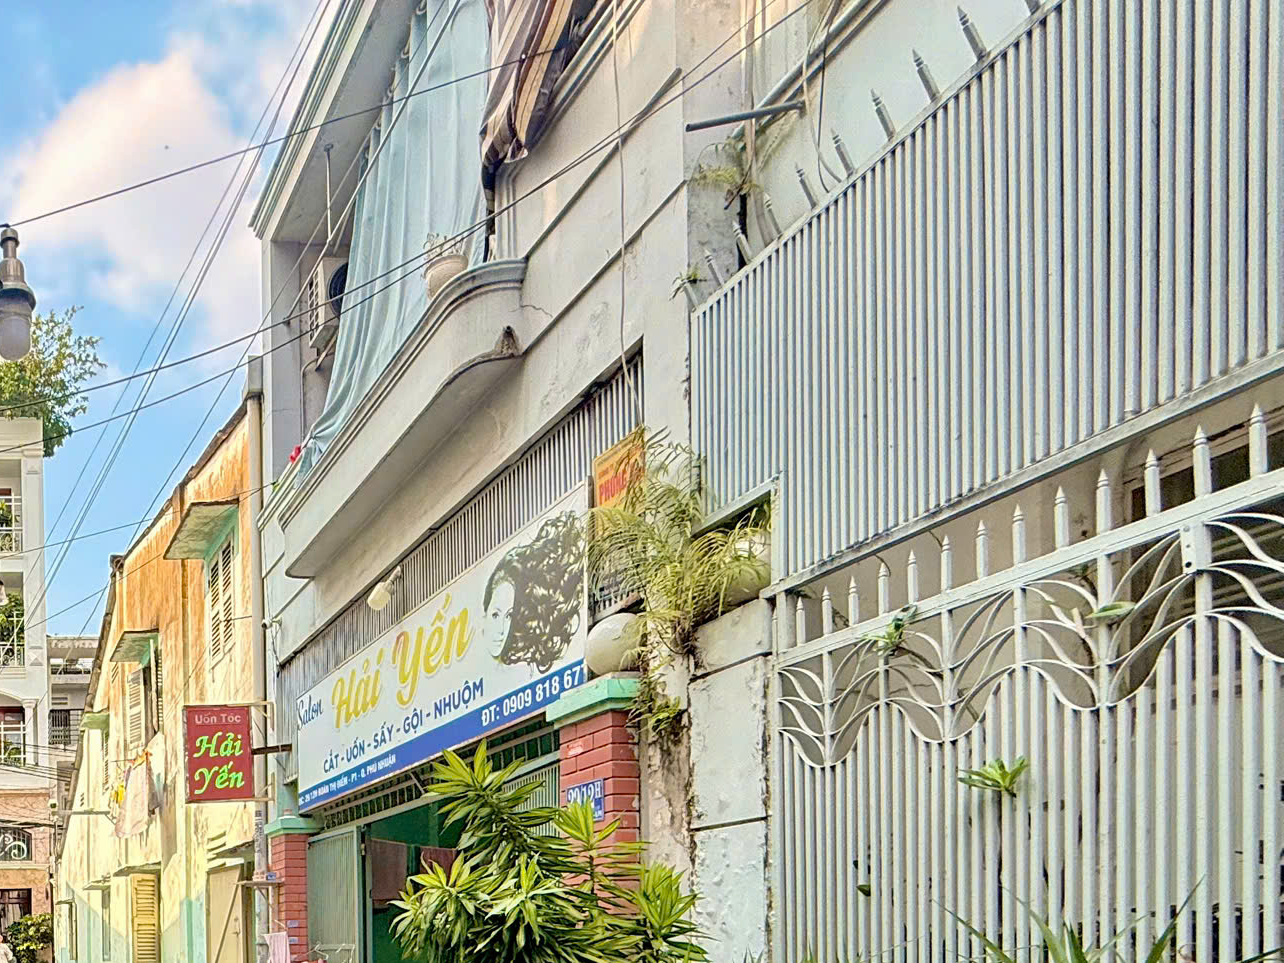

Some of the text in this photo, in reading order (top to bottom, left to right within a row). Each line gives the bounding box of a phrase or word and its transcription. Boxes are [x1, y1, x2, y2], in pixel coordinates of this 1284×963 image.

[297, 592, 471, 730] Salon Hải Yến
[195, 712, 242, 724] Uốn Tóc
[481, 704, 500, 727] ĐT:
[502, 688, 532, 717] 0909
[535, 676, 560, 702] 818
[193, 731, 243, 758] Hải
[323, 749, 339, 774] CẮT
[346, 736, 365, 763] UỐN
[373, 721, 394, 750] SẤY
[403, 708, 422, 734] GỘI
[434, 677, 484, 720] NHUỘM
[194, 761, 245, 795] Yến
